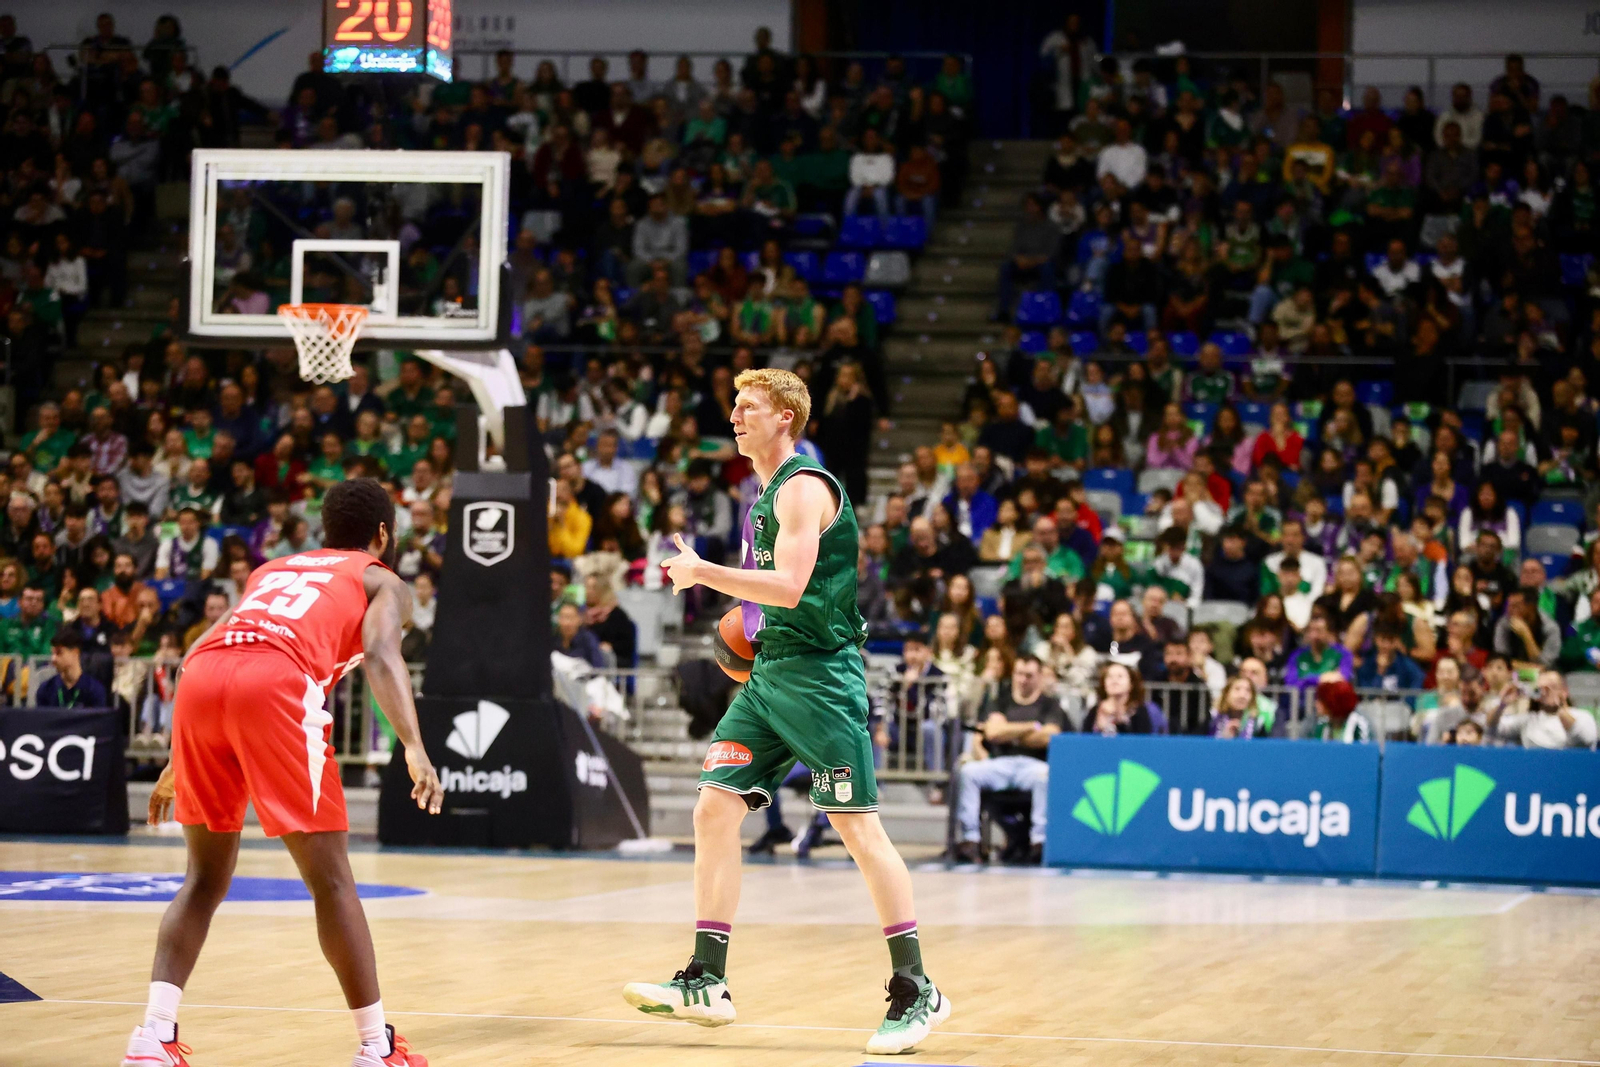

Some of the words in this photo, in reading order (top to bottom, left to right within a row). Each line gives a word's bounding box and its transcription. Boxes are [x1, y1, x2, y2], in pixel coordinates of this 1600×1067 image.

[335, 0, 413, 42] 20
[234, 571, 334, 620] 25
[0, 733, 96, 781] sa
[1167, 787, 1350, 848] Unicaja
